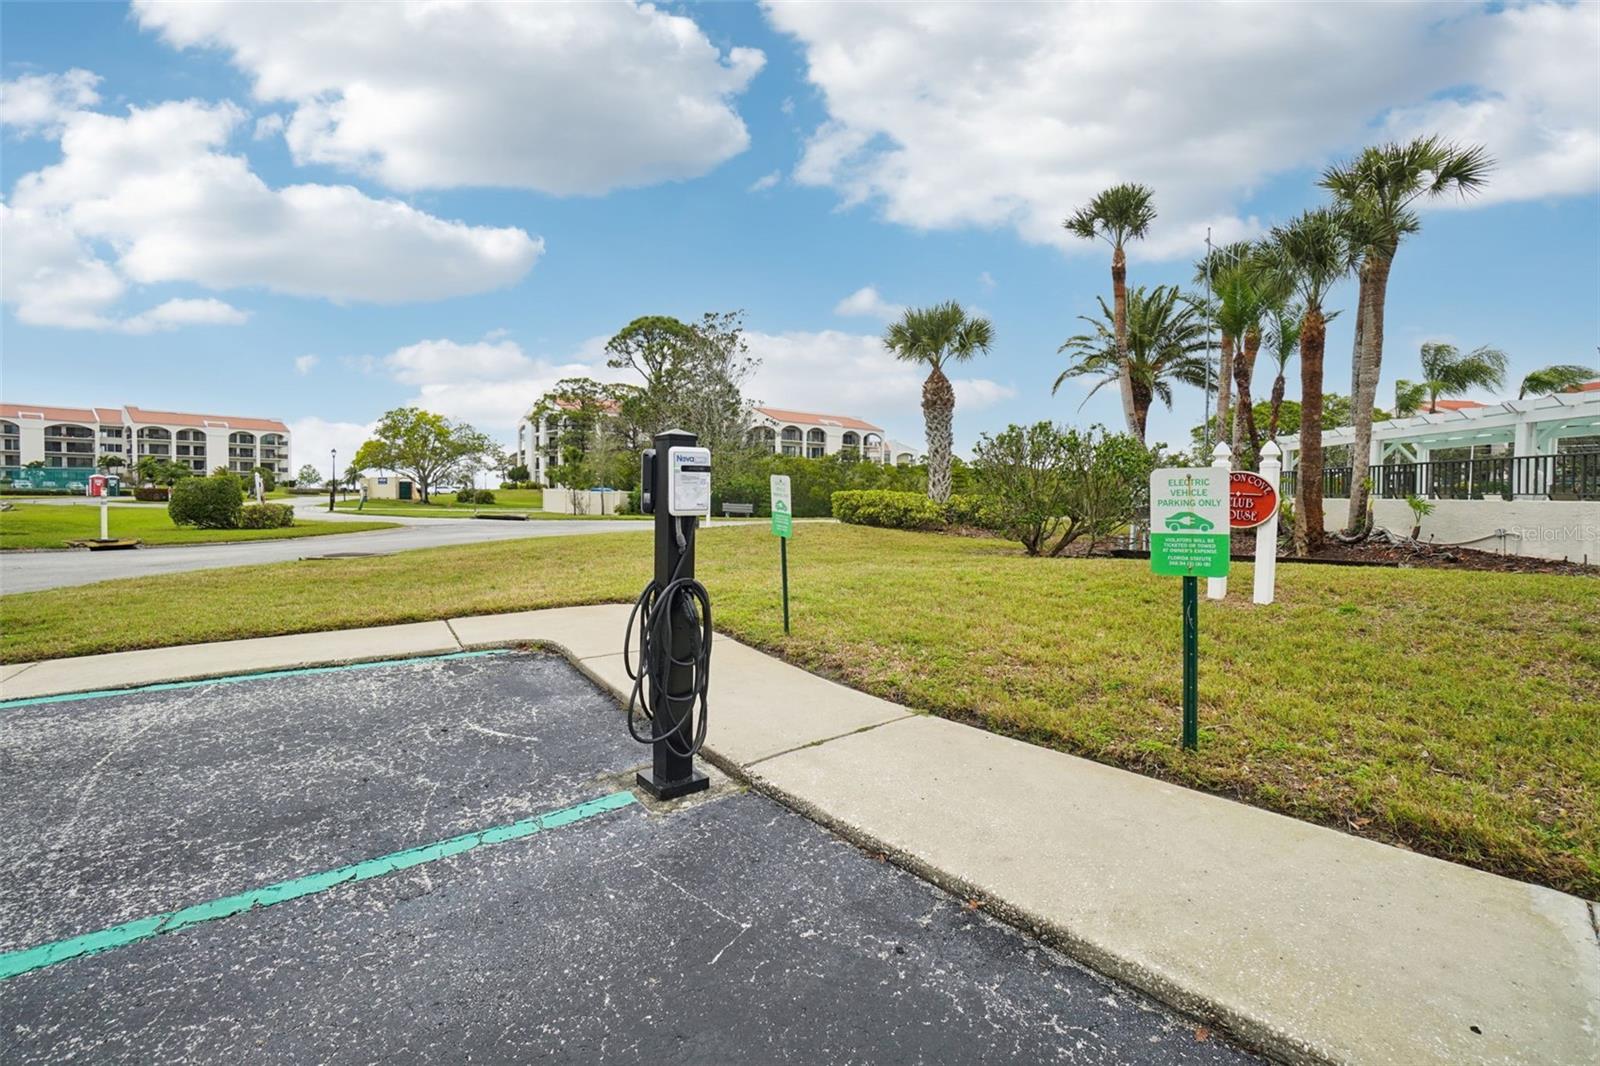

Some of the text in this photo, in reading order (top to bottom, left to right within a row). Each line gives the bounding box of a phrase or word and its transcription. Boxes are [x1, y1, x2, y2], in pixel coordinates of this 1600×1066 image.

[1168, 478, 1210, 486] ELECTRIC
[1157, 499, 1221, 507] PARKING ONLY
